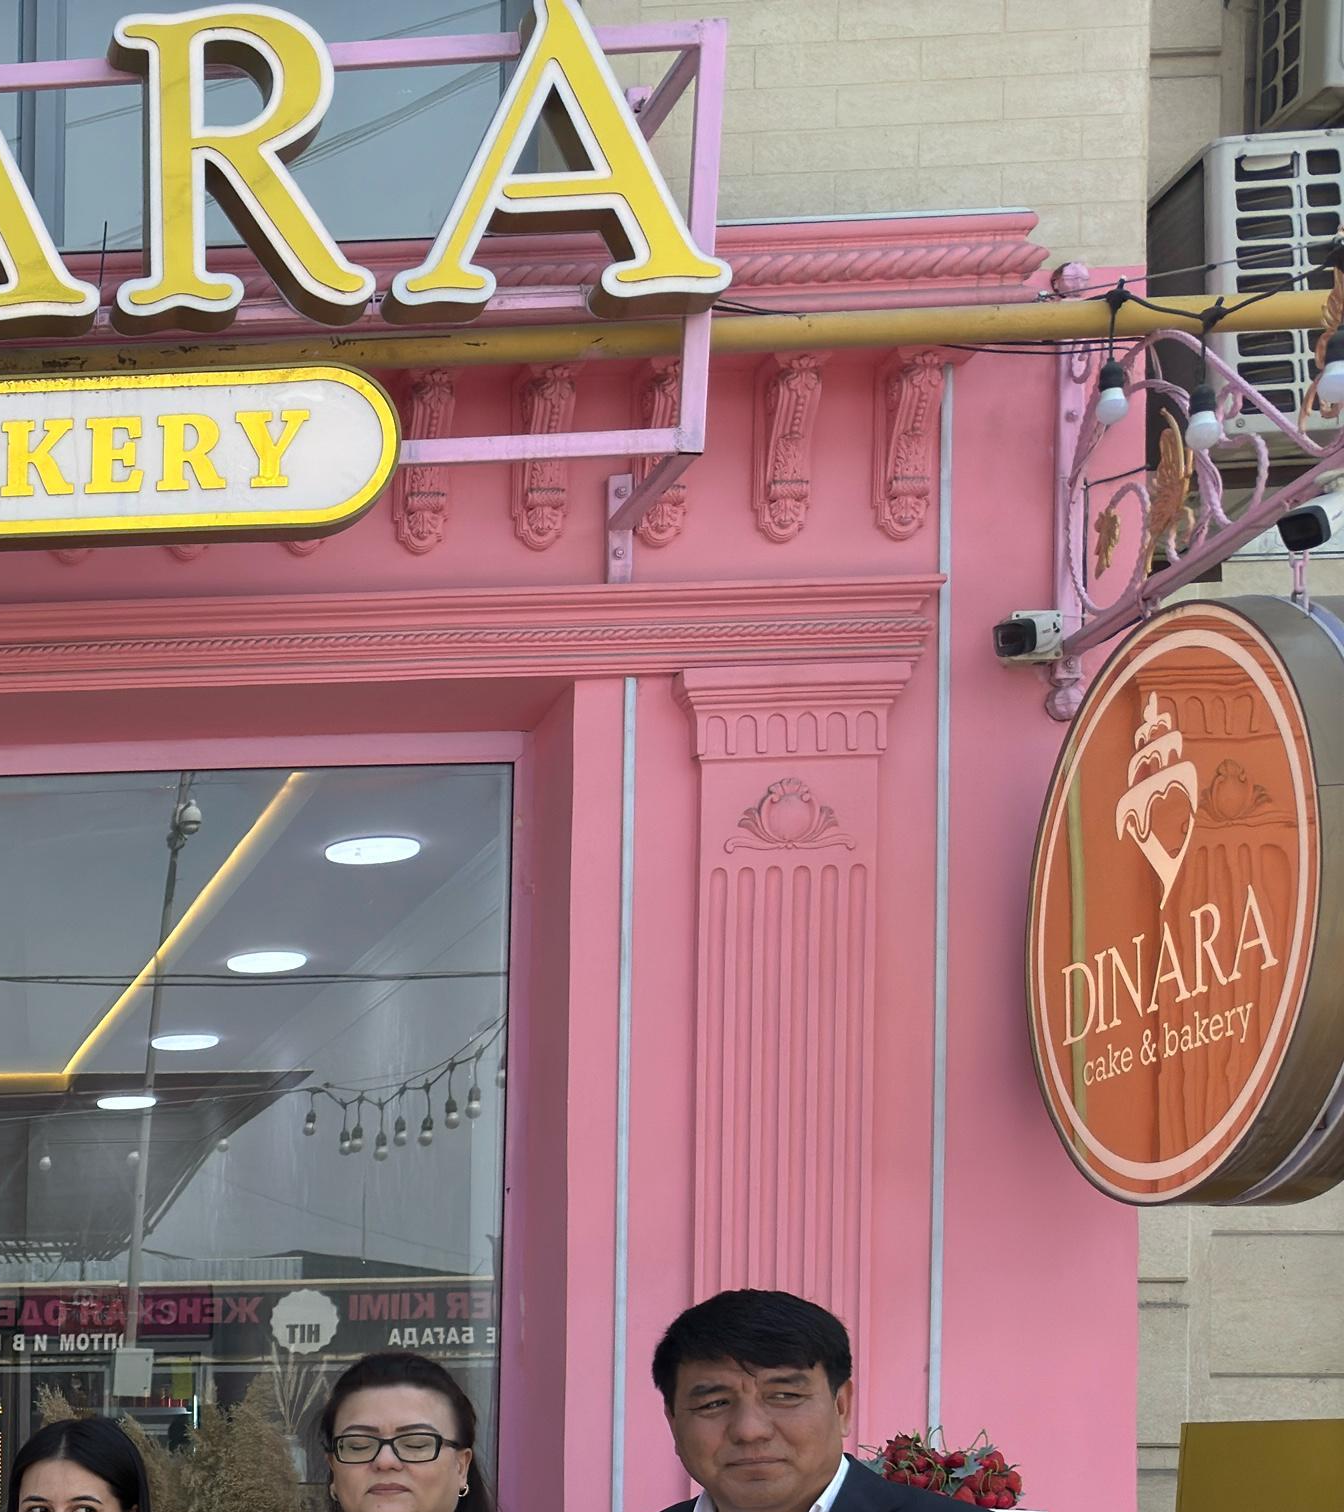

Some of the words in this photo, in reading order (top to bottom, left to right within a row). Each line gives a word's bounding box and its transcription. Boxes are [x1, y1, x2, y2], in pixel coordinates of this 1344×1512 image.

[1061, 885, 1278, 1047] DINARA
[1083, 1043, 1134, 1086] cake
[1139, 1029, 1158, 1066] &
[1162, 1002, 1255, 1059] bakery
